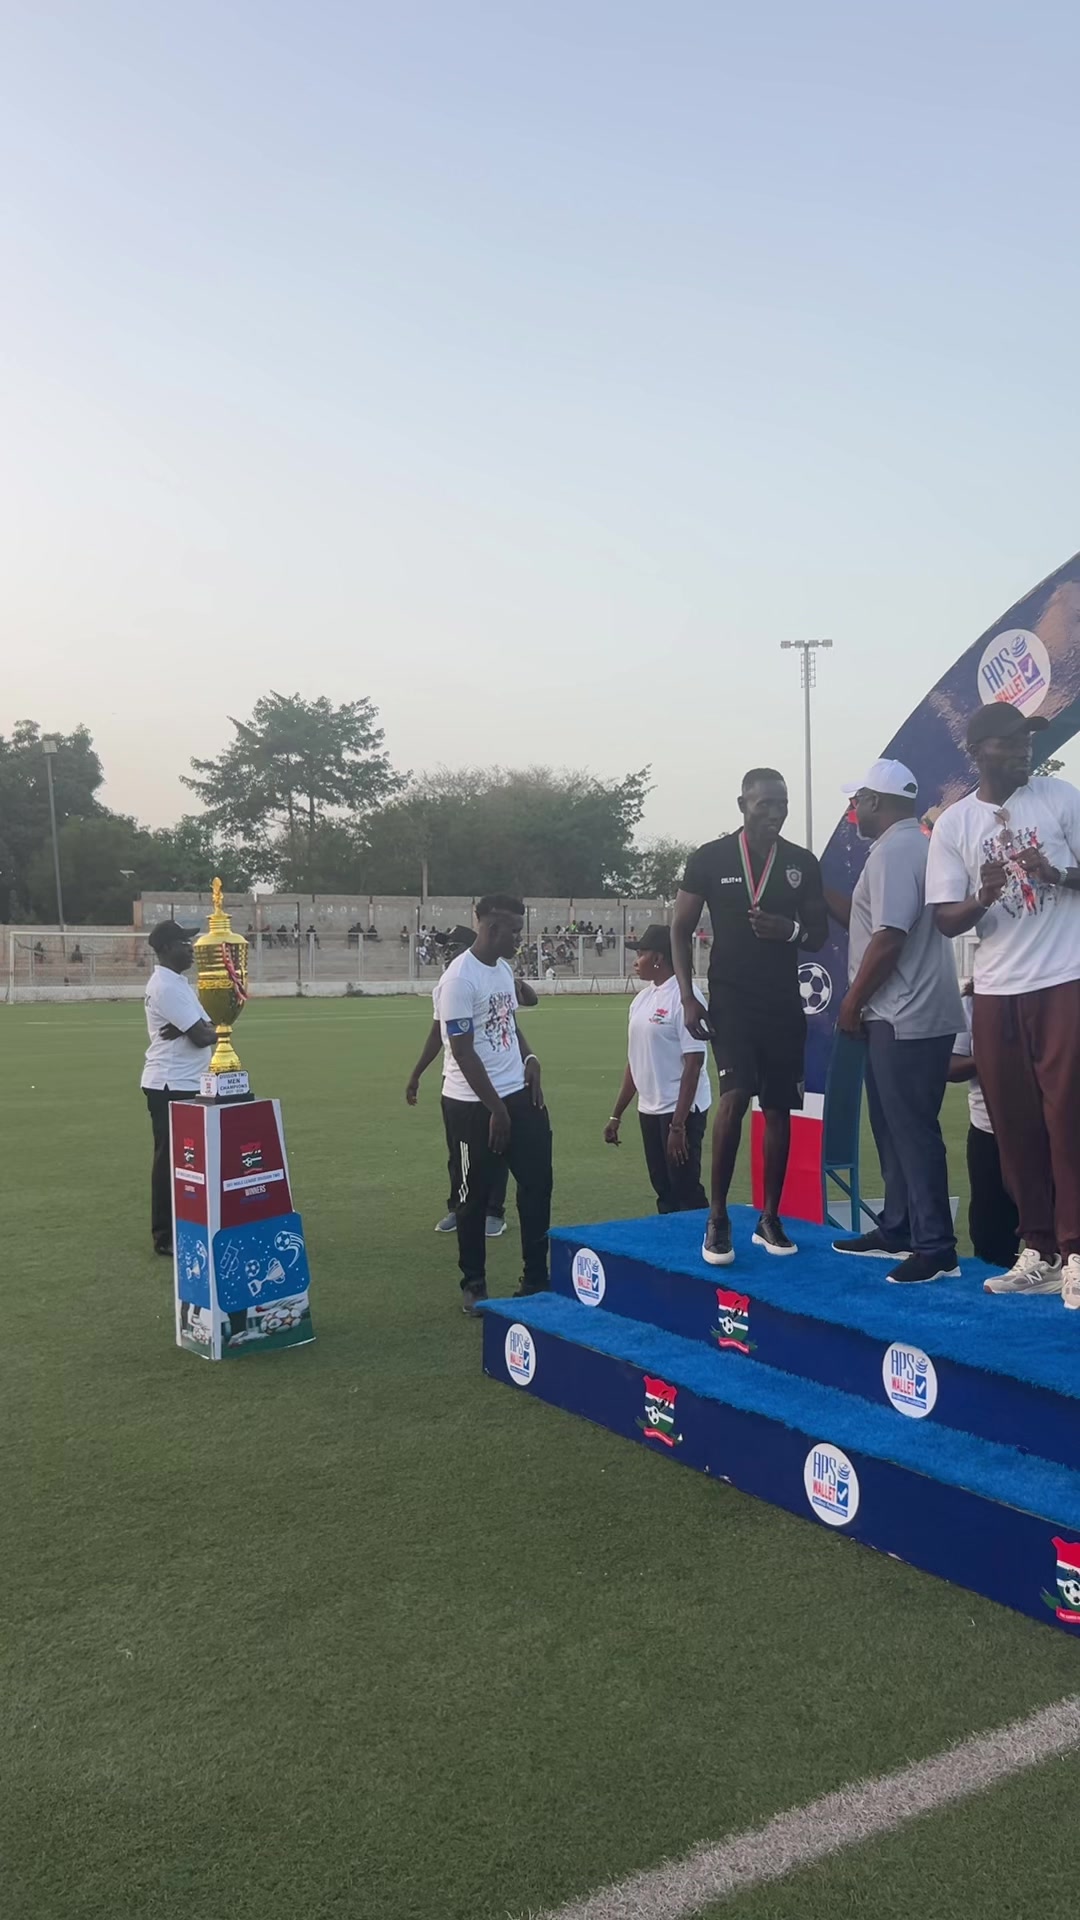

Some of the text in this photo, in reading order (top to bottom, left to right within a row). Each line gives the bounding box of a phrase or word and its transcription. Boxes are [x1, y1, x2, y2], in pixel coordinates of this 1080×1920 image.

[981, 647, 1019, 694] APS
[576, 1255, 592, 1279] APS
[509, 1330, 524, 1356] APS
[891, 1349, 915, 1381] APS
[891, 1376, 915, 1397] WALLET
[813, 1451, 837, 1486] APS
[812, 1480, 837, 1503] WALLET
